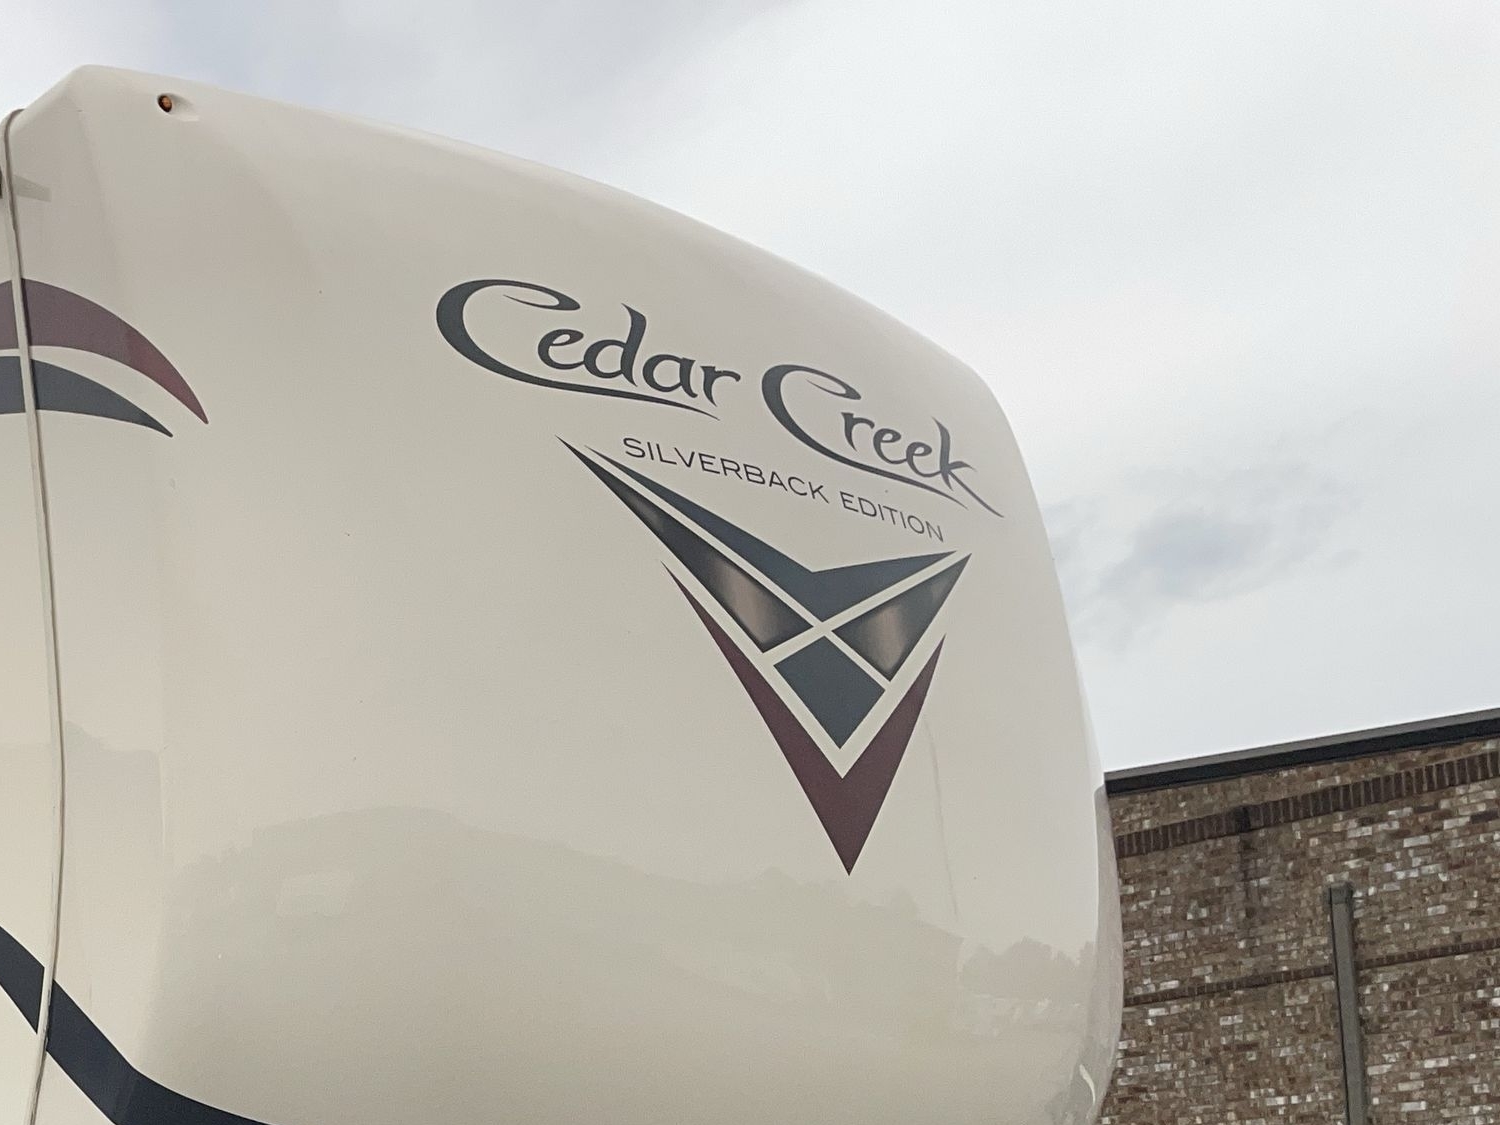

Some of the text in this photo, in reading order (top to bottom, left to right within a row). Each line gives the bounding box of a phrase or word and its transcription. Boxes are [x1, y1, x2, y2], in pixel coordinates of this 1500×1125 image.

[436, 279, 1005, 518] Cedar Creek
[623, 437, 944, 543] SILVERBACK EDITION
